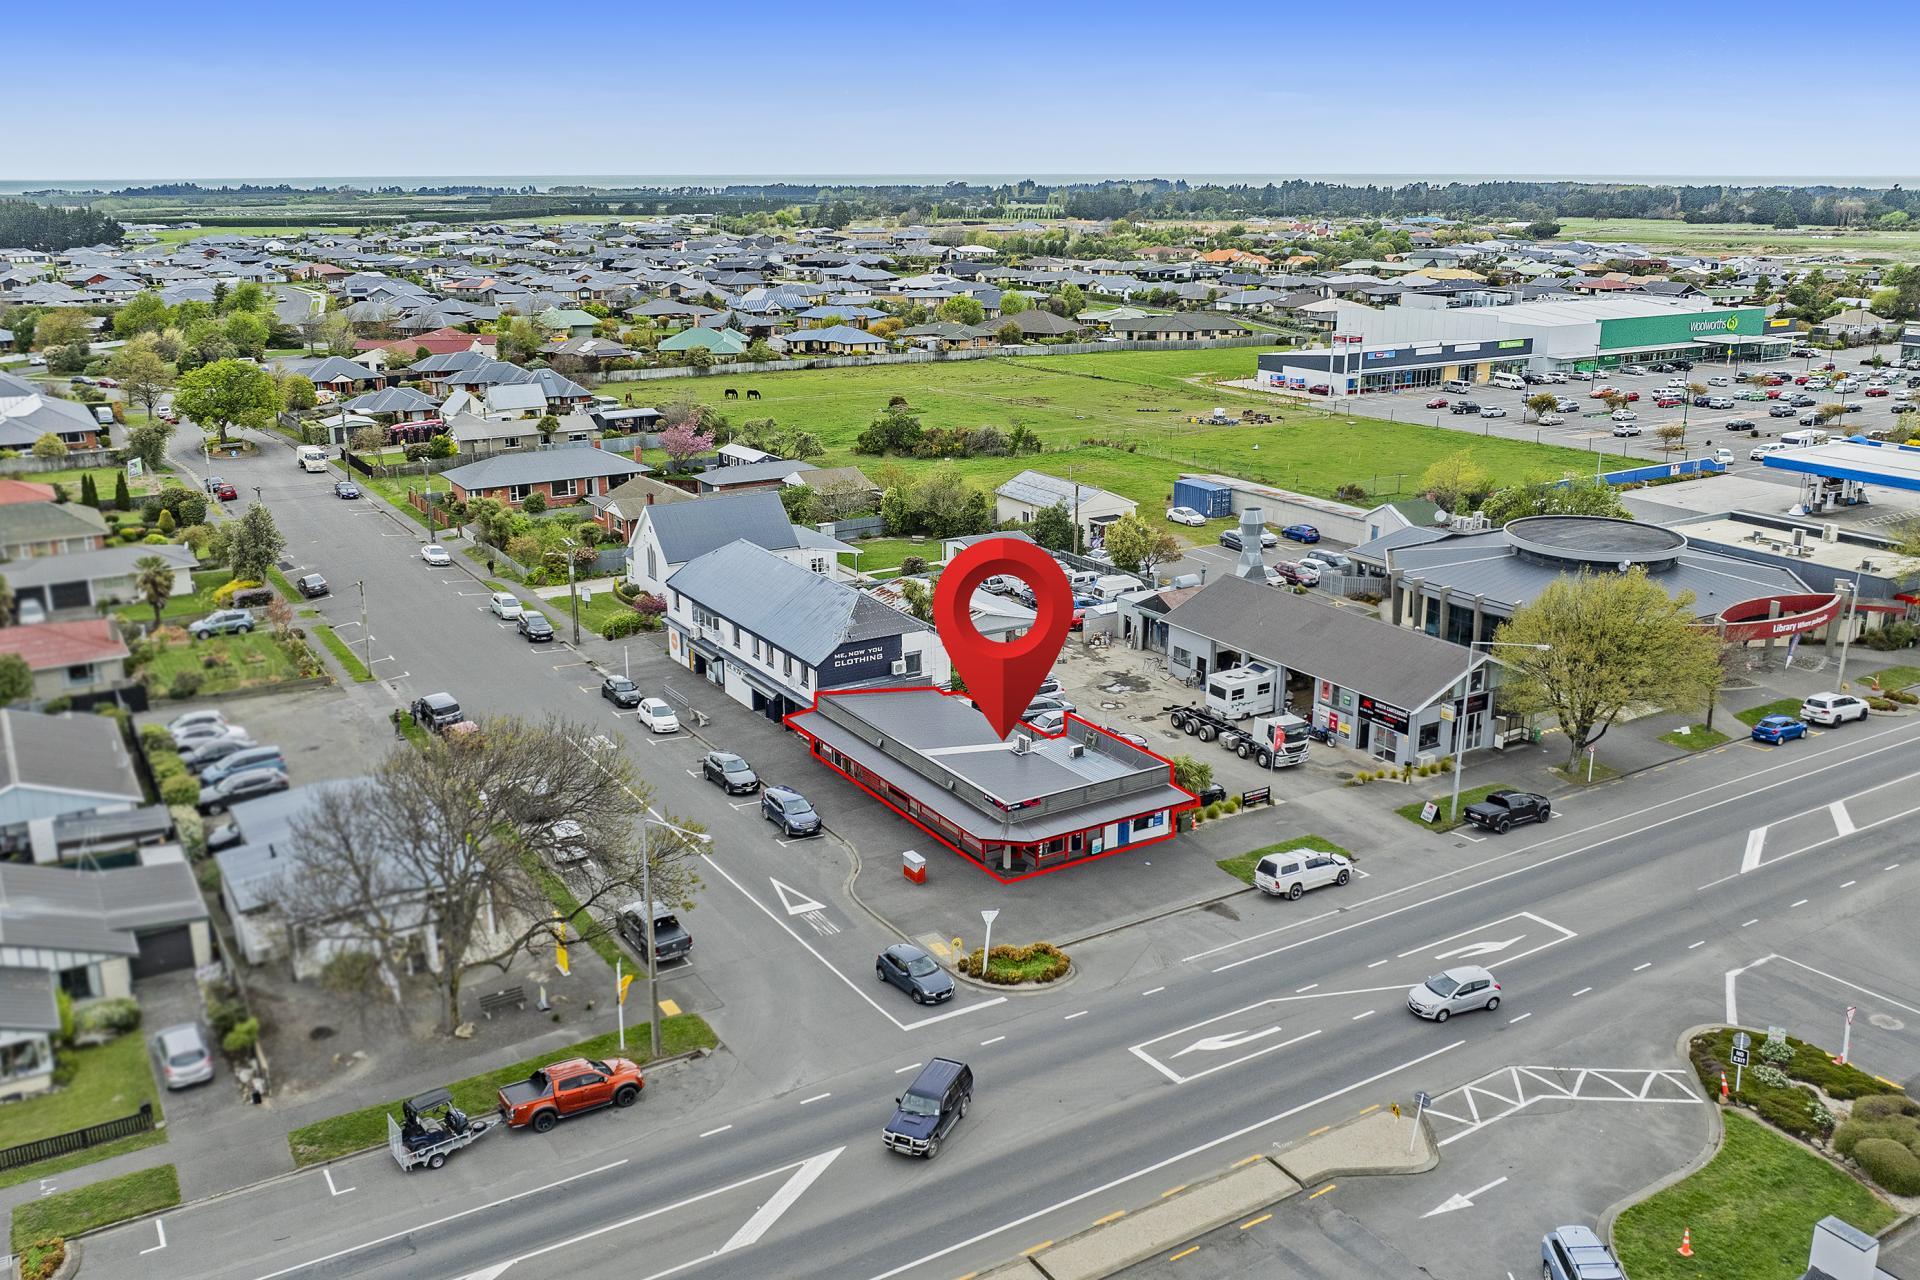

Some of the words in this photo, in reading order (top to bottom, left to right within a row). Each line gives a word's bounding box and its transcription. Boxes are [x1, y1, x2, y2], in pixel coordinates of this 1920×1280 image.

[1690, 319, 1727, 332] Woolworths
[1772, 622, 1797, 633] Library
[848, 649, 866, 657] NOW
[868, 646, 883, 654] YOU
[834, 653, 883, 667] CLOTHING
[1733, 1055, 1746, 1064] EXIT
